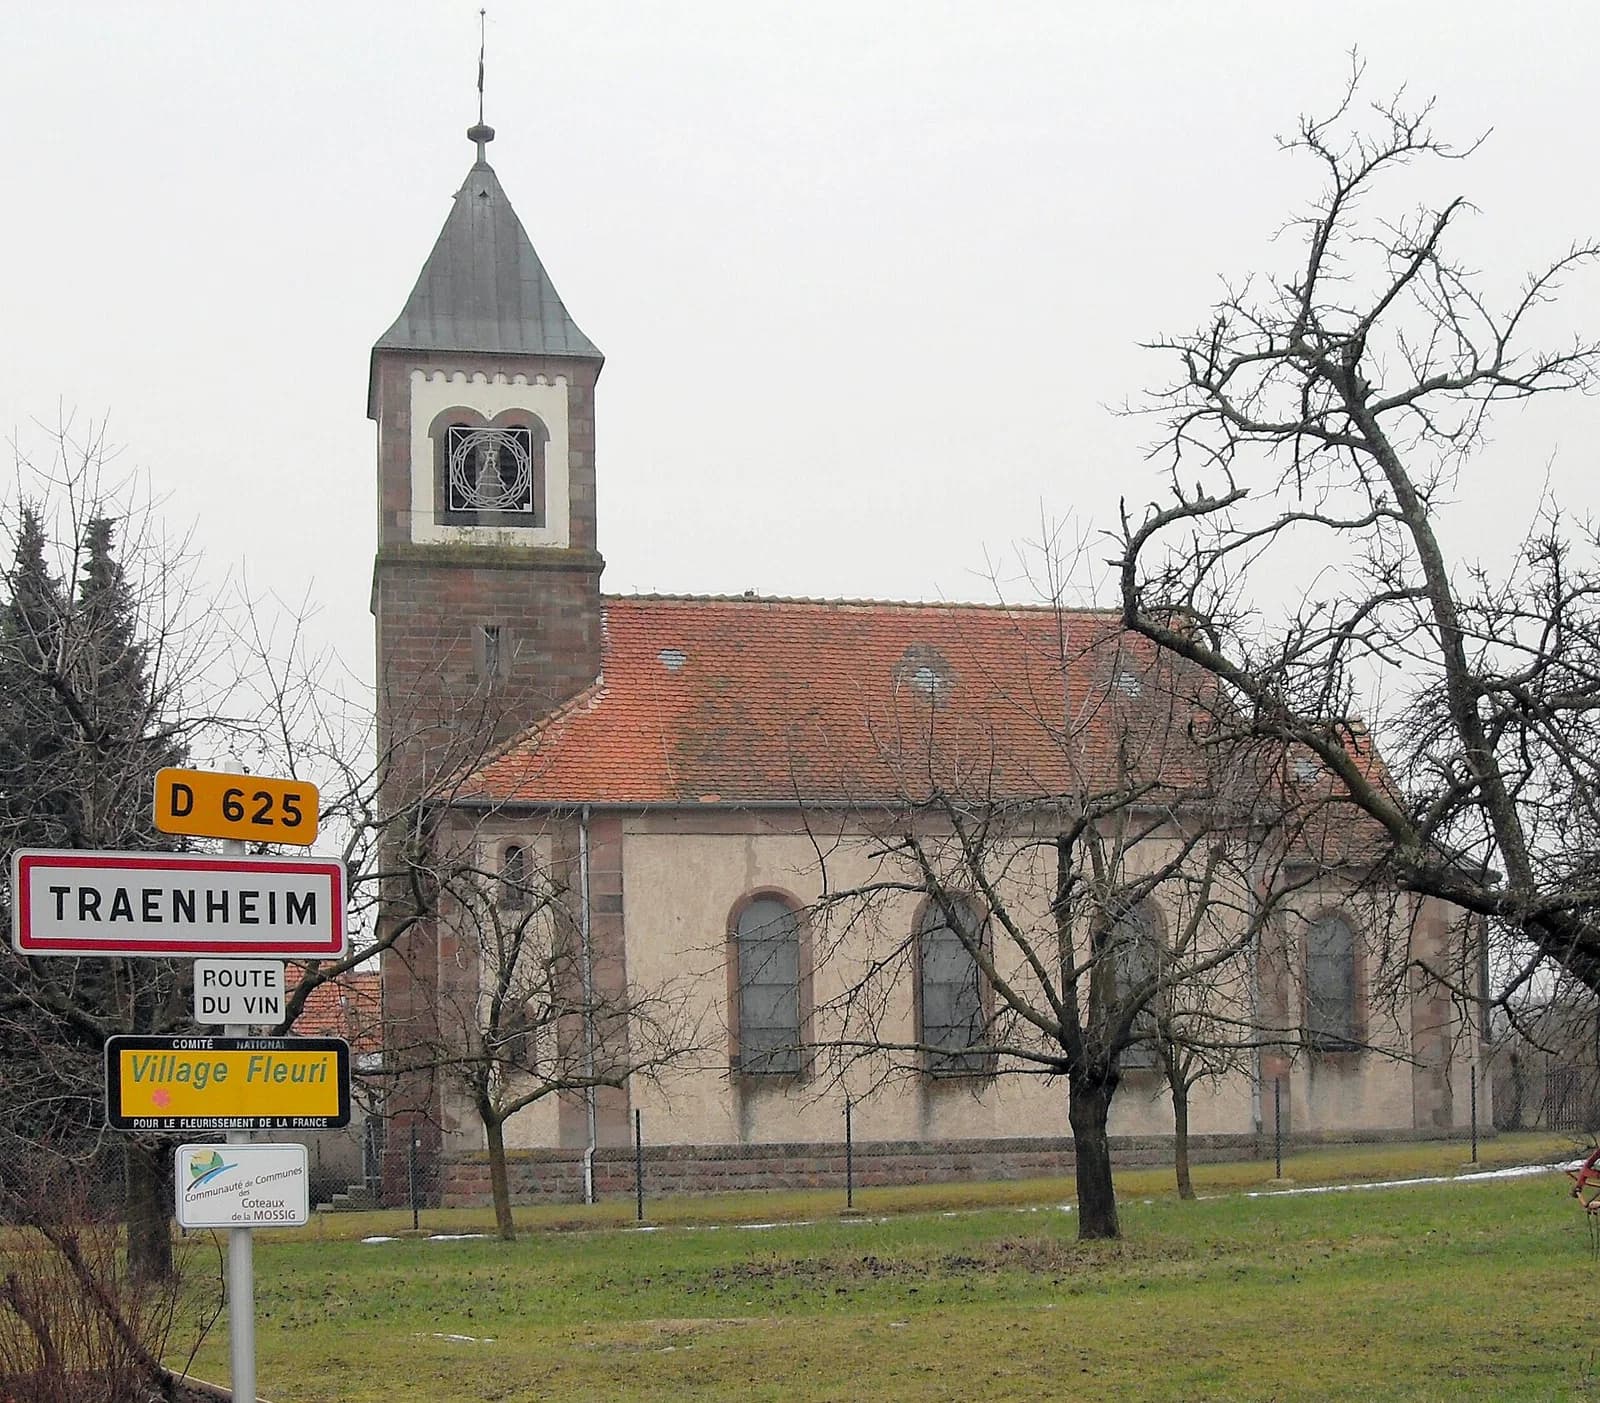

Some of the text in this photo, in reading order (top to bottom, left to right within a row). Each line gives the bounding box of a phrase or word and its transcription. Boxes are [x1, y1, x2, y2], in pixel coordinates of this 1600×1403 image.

[171, 783, 303, 827] D 625
[49, 886, 317, 925] TRAENHEIM
[203, 970, 276, 988] ROUTE
[203, 996, 278, 1014] DU VIN
[172, 1038, 214, 1049] COMITÉ
[131, 1055, 328, 1089] Village Fleuri
[133, 1118, 327, 1128] POUR LE FLEURISSEMENT DE LA FRANCE
[185, 1181, 243, 1202] Communauté
[255, 1166, 303, 1185] Communes
[239, 1188, 250, 1197] des
[242, 1198, 284, 1208] Coteaux
[232, 1210, 296, 1221] de la MOSSIG
